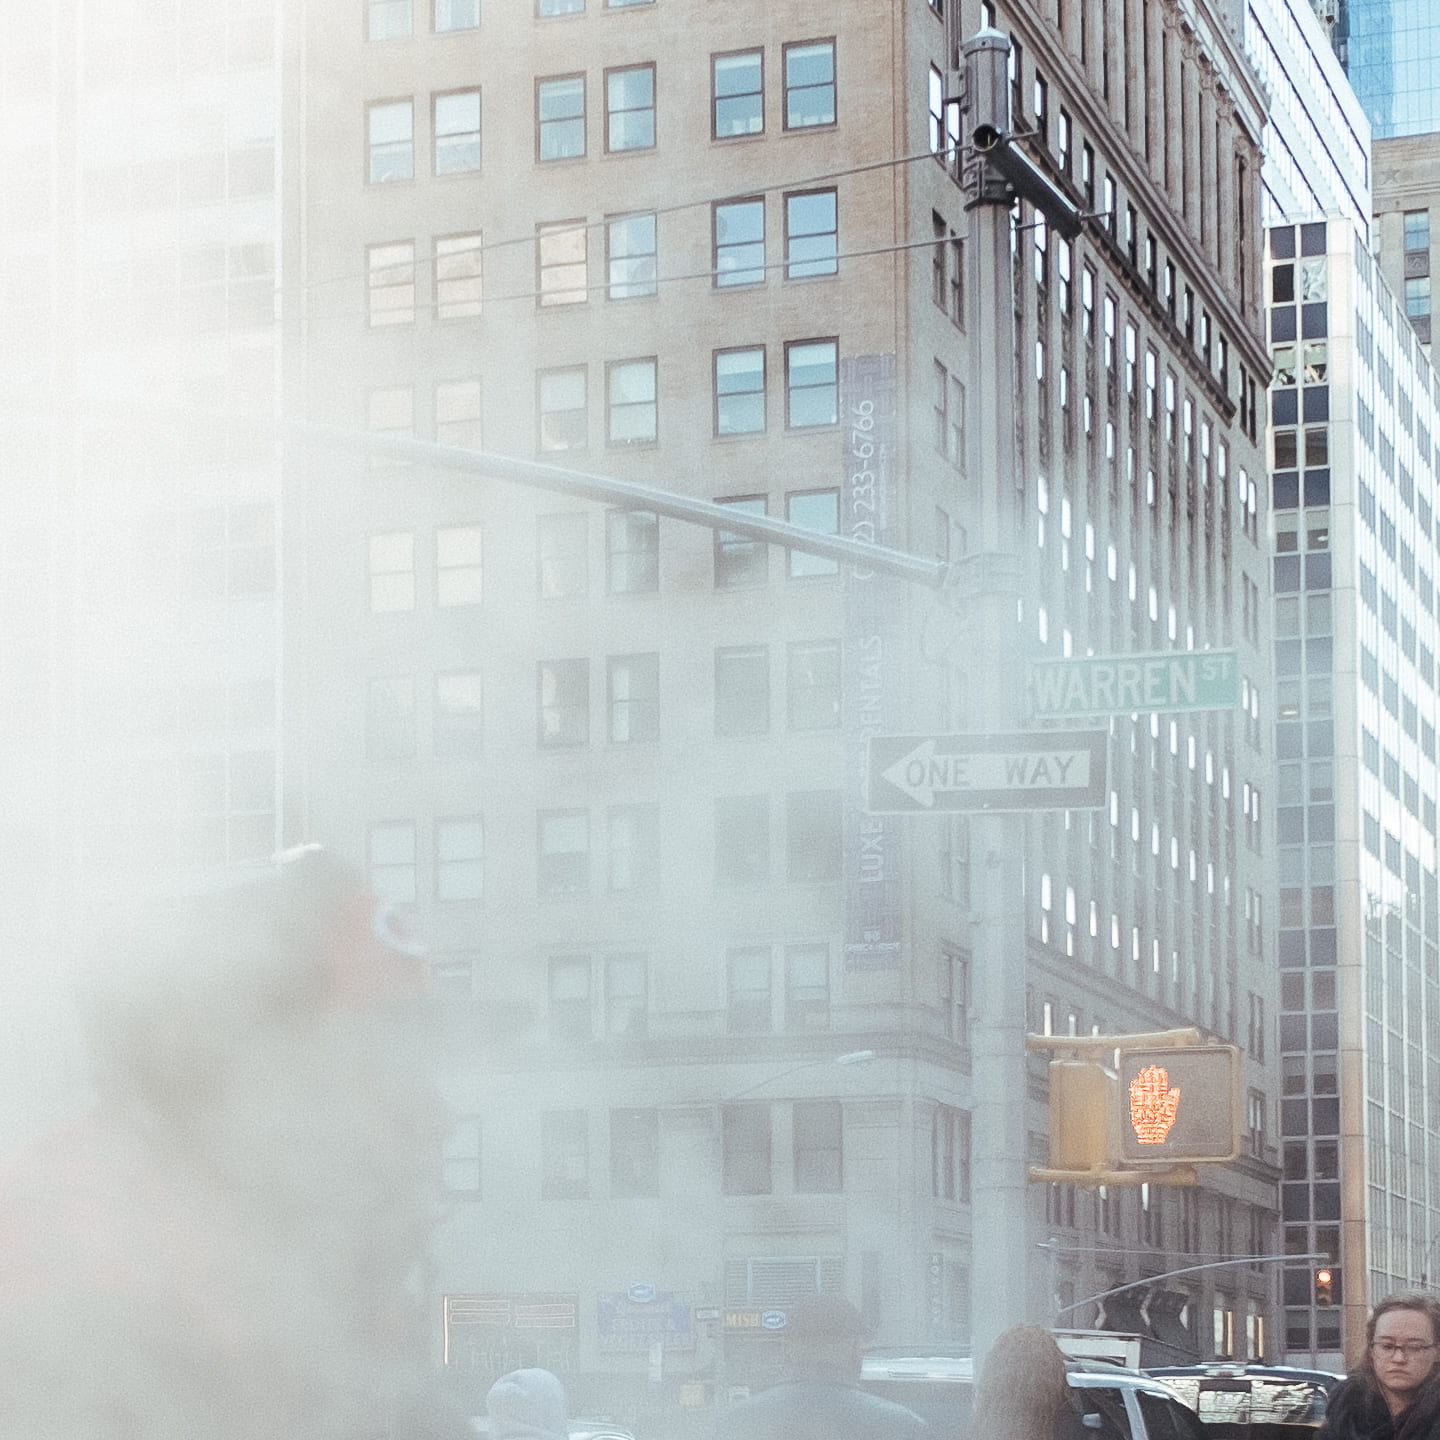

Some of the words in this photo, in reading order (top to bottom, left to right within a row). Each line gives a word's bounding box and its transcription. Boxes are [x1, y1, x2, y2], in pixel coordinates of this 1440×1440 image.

[852, 399, 875, 515] 233-6766
[1035, 660, 1196, 711] WARREN
[1201, 655, 1231, 682] ST
[906, 758, 970, 788] ONE
[1005, 754, 1075, 786] WAY
[860, 821, 884, 883] LUXE
